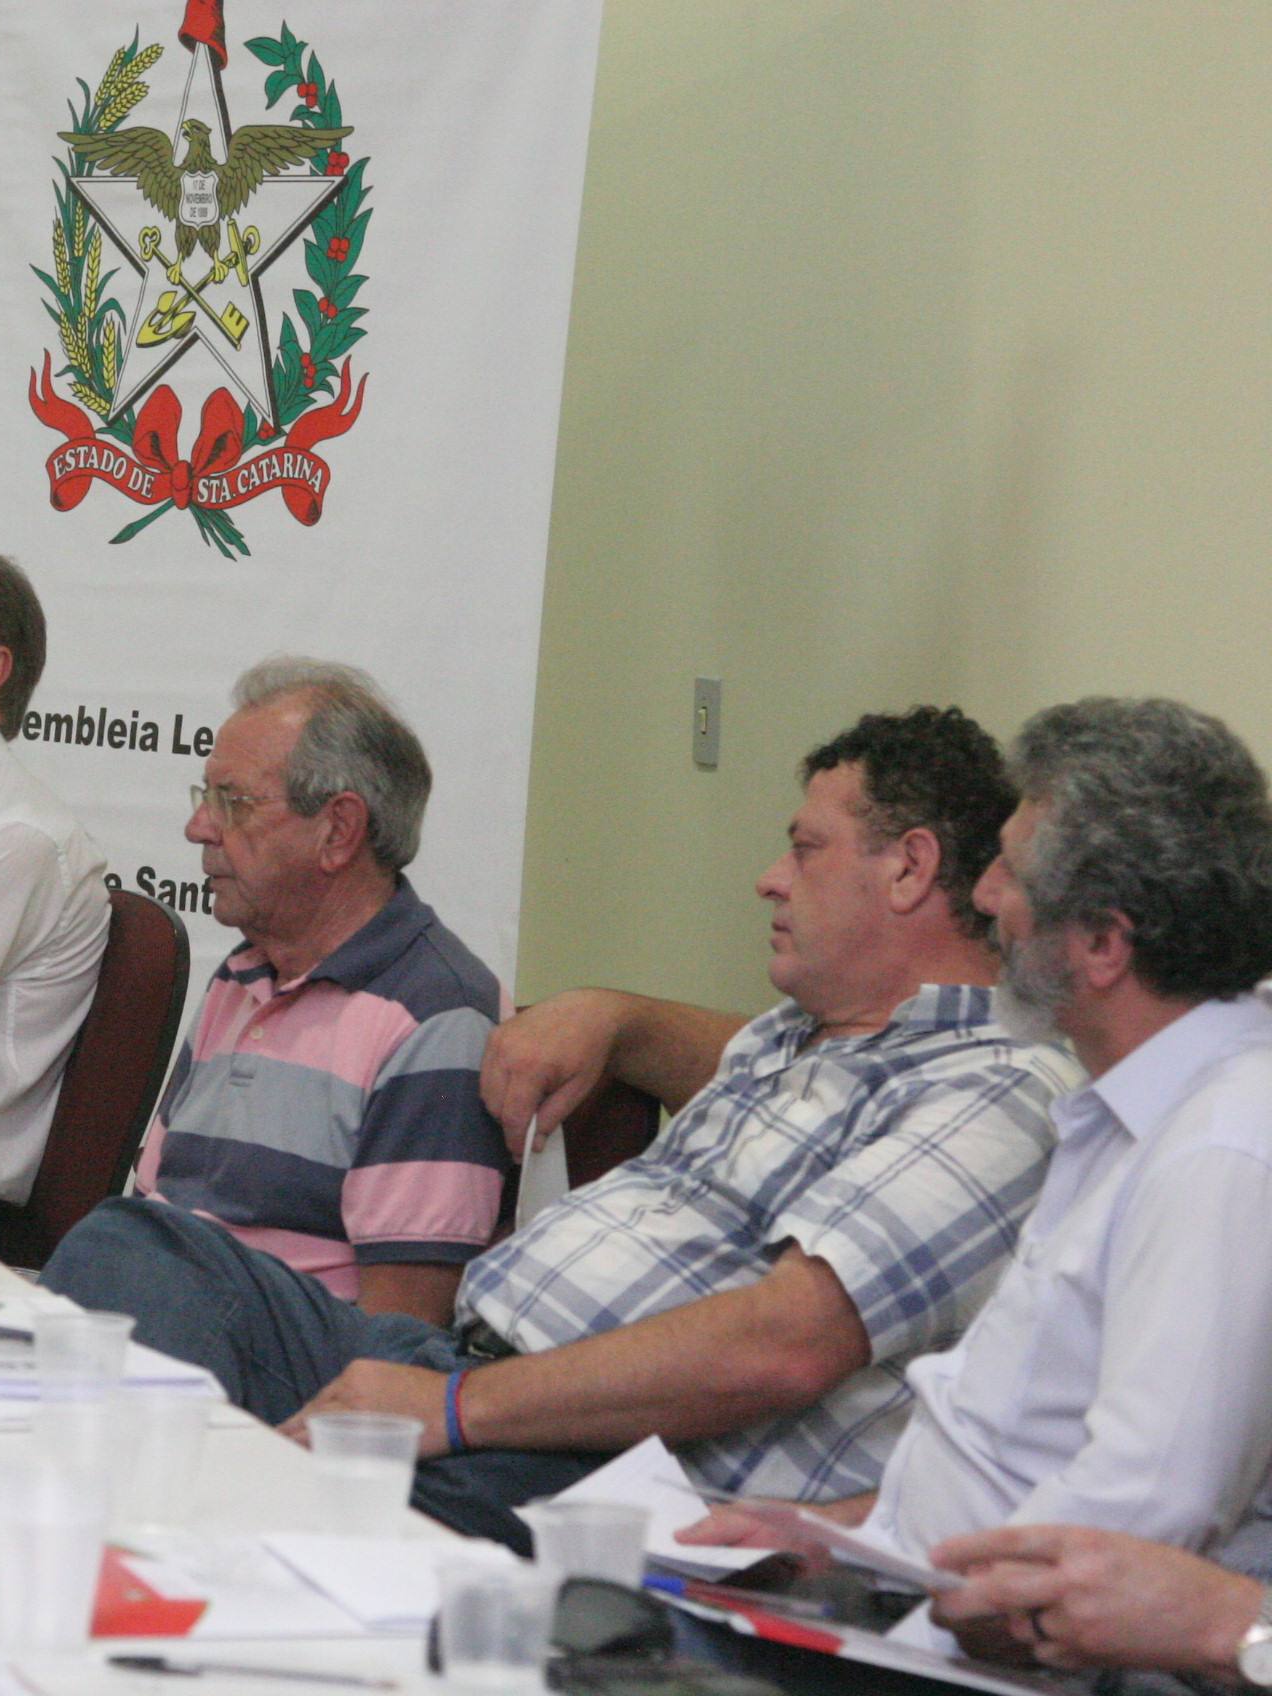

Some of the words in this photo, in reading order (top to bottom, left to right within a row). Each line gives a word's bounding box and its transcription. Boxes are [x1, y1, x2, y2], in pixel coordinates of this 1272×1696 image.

[185, 193, 213, 204] NOVEMBRO
[190, 207, 197, 218] DE
[53, 445, 126, 481] ESTADO
[128, 469, 156, 499] DE
[237, 454, 325, 494] CATARINA
[172, 714, 214, 757] Le
